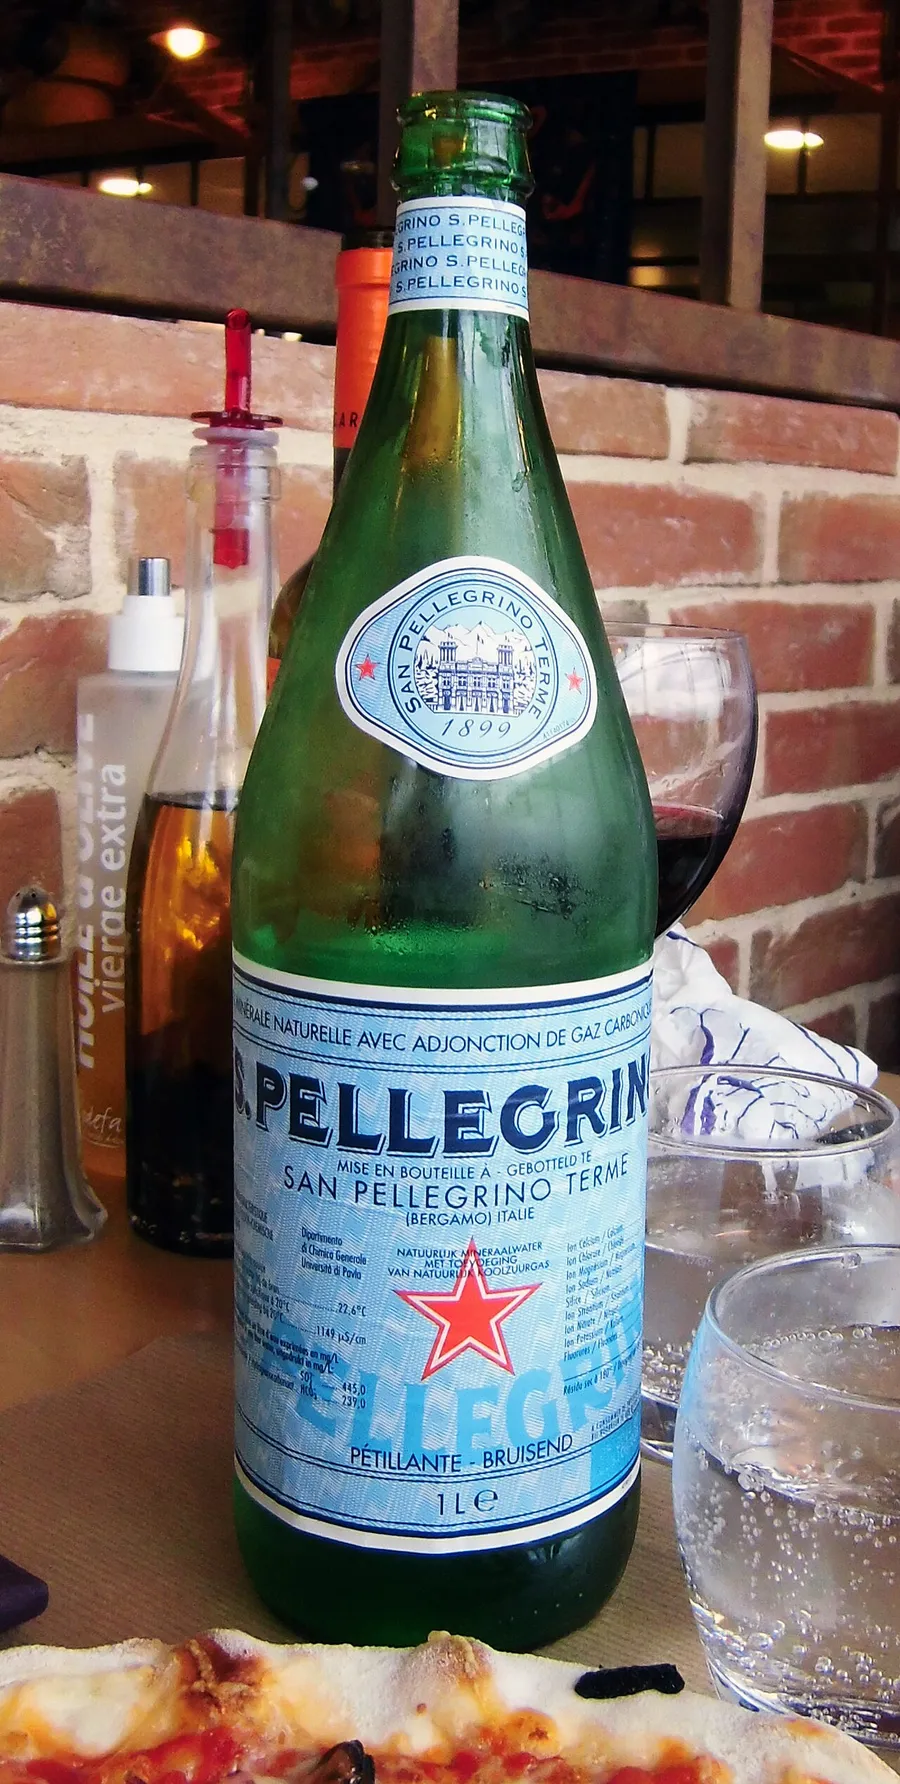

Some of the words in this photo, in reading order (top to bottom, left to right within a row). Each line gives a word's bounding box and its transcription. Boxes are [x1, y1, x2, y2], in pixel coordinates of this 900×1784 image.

[397, 234, 518, 254] S.PELLEGRINO
[395, 275, 519, 295] S.PELLEGRINO
[399, 589, 533, 652] PELLEGRINO
[398, 664, 422, 714] SAN
[528, 637, 551, 720] TERME
[441, 718, 512, 739] 1899
[97, 764, 127, 871] extra
[235, 998, 271, 1029] NÉRALE
[273, 1014, 352, 1046] NATURELLE
[357, 1031, 406, 1051] AVEC
[412, 1032, 540, 1053] ADJONCTION
[546, 1029, 566, 1047] DE
[571, 1023, 601, 1044] GAZ
[234, 1045, 650, 1159] S.PELLEGRIN
[337, 1160, 369, 1175] MISE
[374, 1164, 395, 1178] EN
[400, 1166, 475, 1180] BOUTEILLE
[480, 1162, 491, 1179] À
[506, 1155, 578, 1177] GEBOTTELD
[581, 1150, 592, 1164] TE
[284, 1165, 338, 1200] SAN
[354, 1178, 551, 1209] PELLEGRINO
[566, 1152, 629, 1195] TERME
[406, 1211, 492, 1227] (BERGAMO)
[497, 1207, 535, 1223] ITALIE
[396, 1248, 457, 1259] NATUURLIJK
[424, 1259, 444, 1269] MET
[388, 1267, 410, 1277] VAN
[316, 1325, 335, 1339] 1149
[342, 1382, 366, 1396] 445,0
[342, 1395, 366, 1410] 239,0
[350, 1443, 461, 1473] PÉTILLANTE
[483, 1434, 573, 1470] BRUISEND
